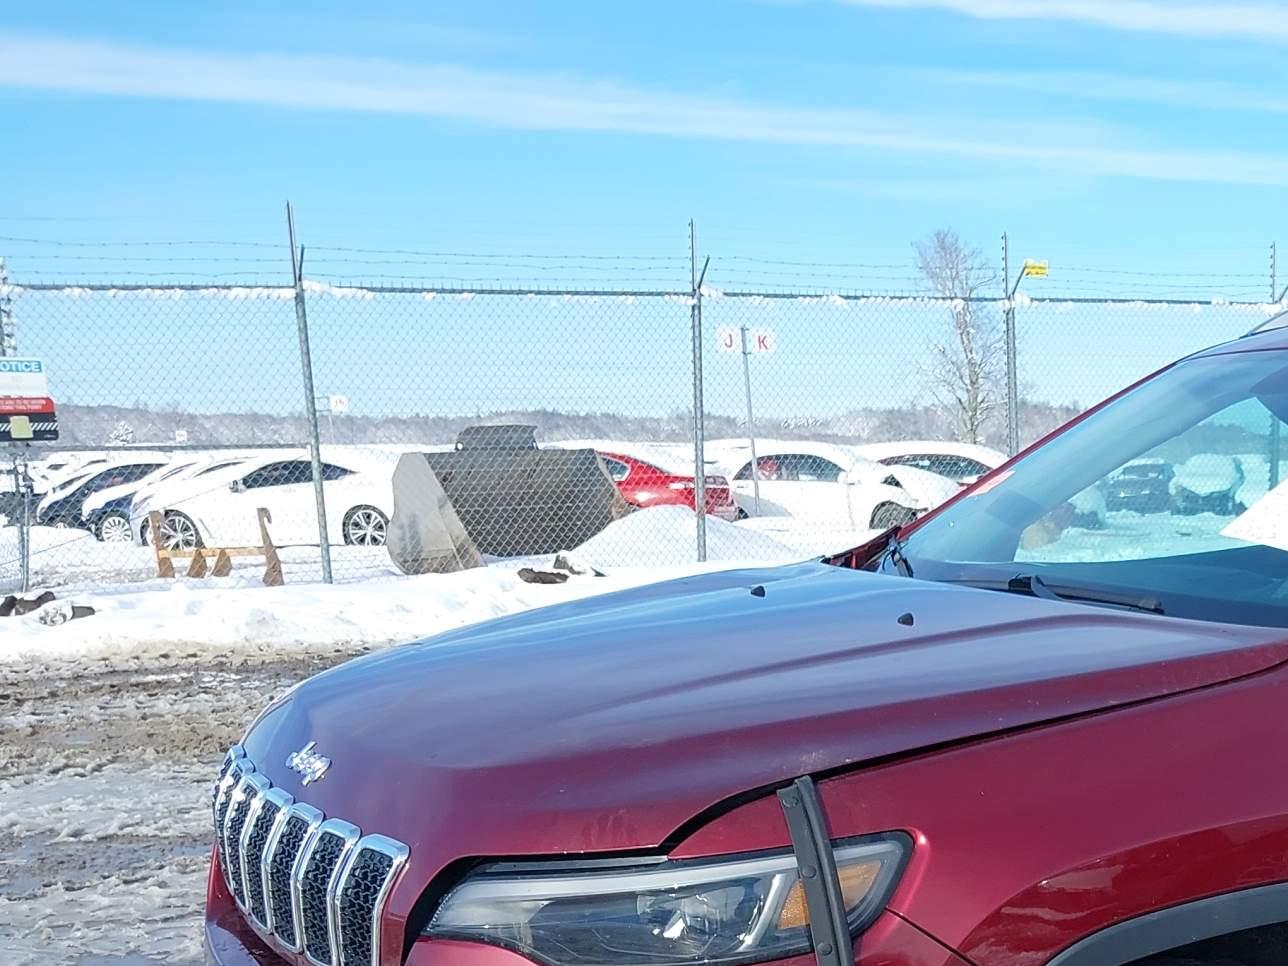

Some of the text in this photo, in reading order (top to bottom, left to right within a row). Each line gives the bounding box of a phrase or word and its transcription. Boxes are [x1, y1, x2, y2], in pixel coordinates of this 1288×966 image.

[724, 333, 733, 348] J
[758, 335, 768, 350] K
[0, 361, 42, 372] OTICE
